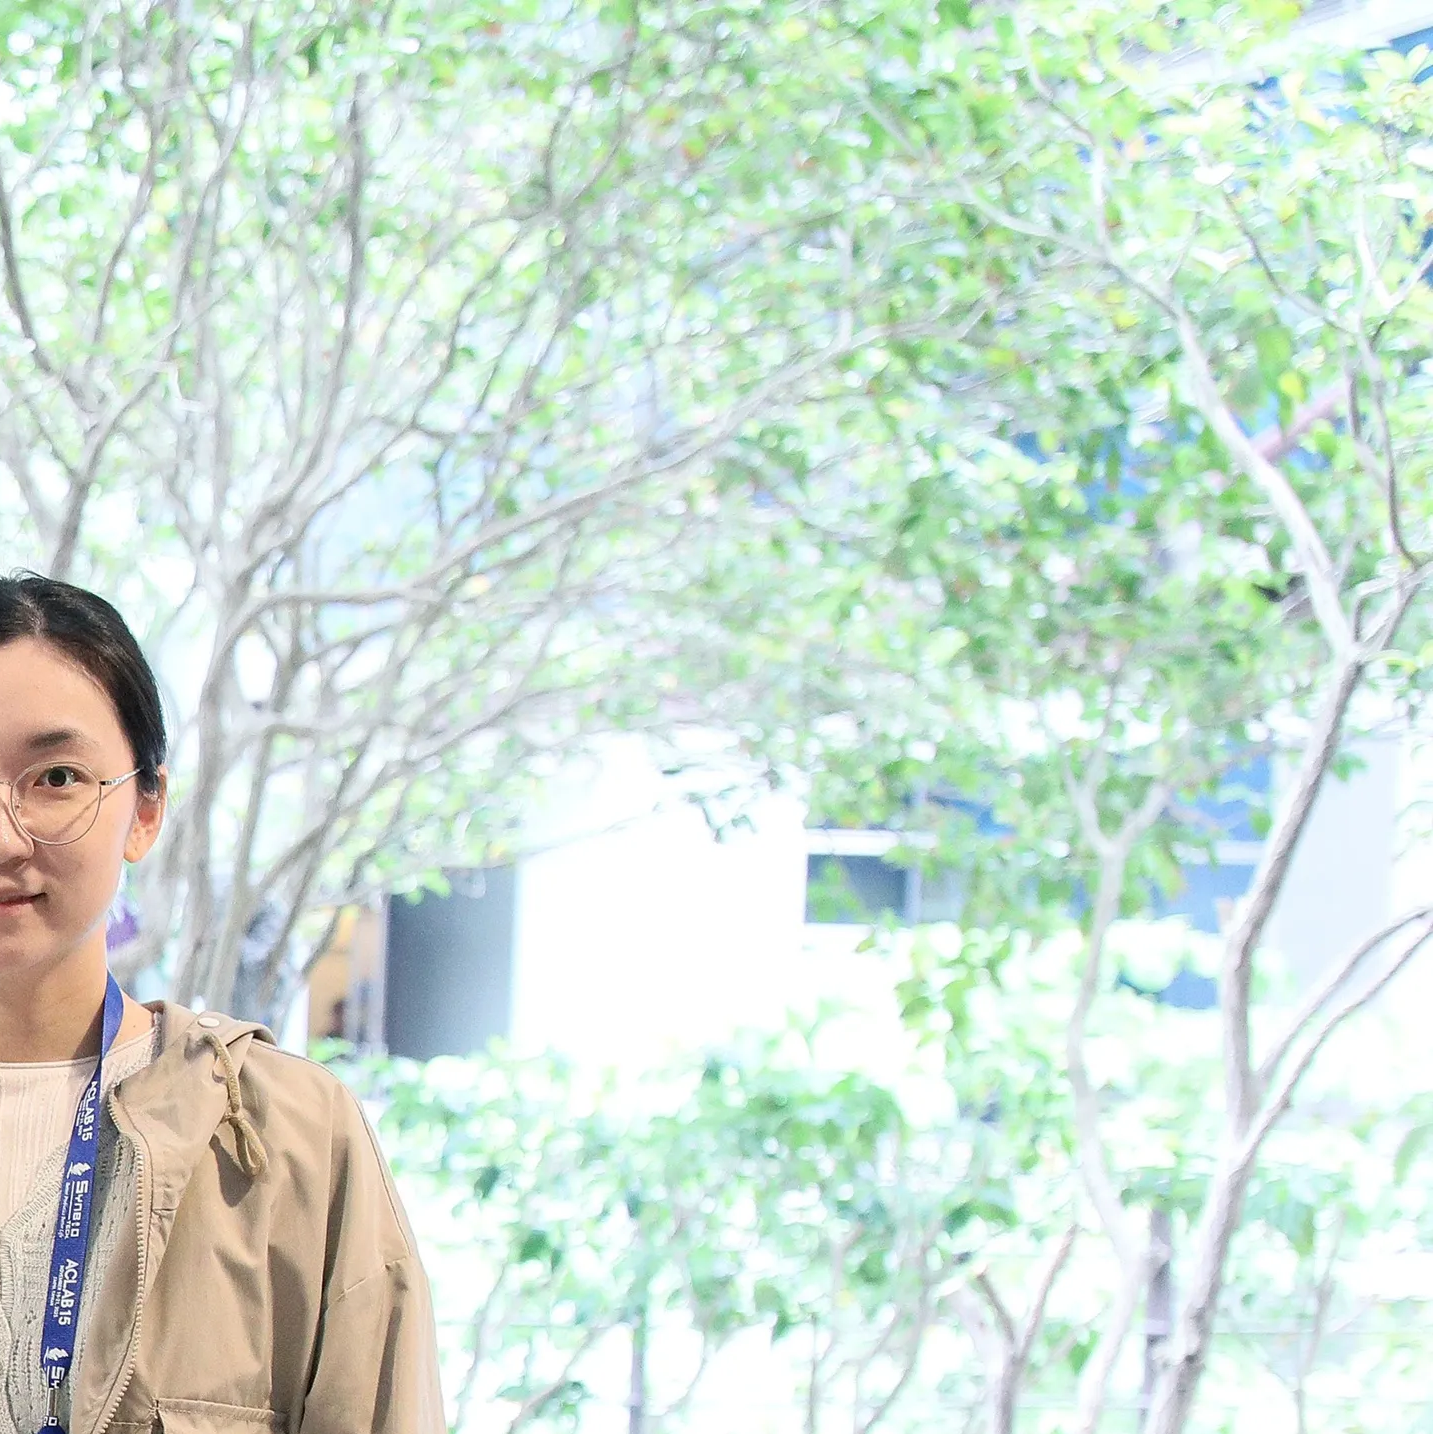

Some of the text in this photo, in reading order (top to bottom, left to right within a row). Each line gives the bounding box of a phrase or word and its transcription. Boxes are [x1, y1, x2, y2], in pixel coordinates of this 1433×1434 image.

[81, 1080, 97, 1141] ACLAB 15
[57, 1258, 78, 1325] ACLAB 15
